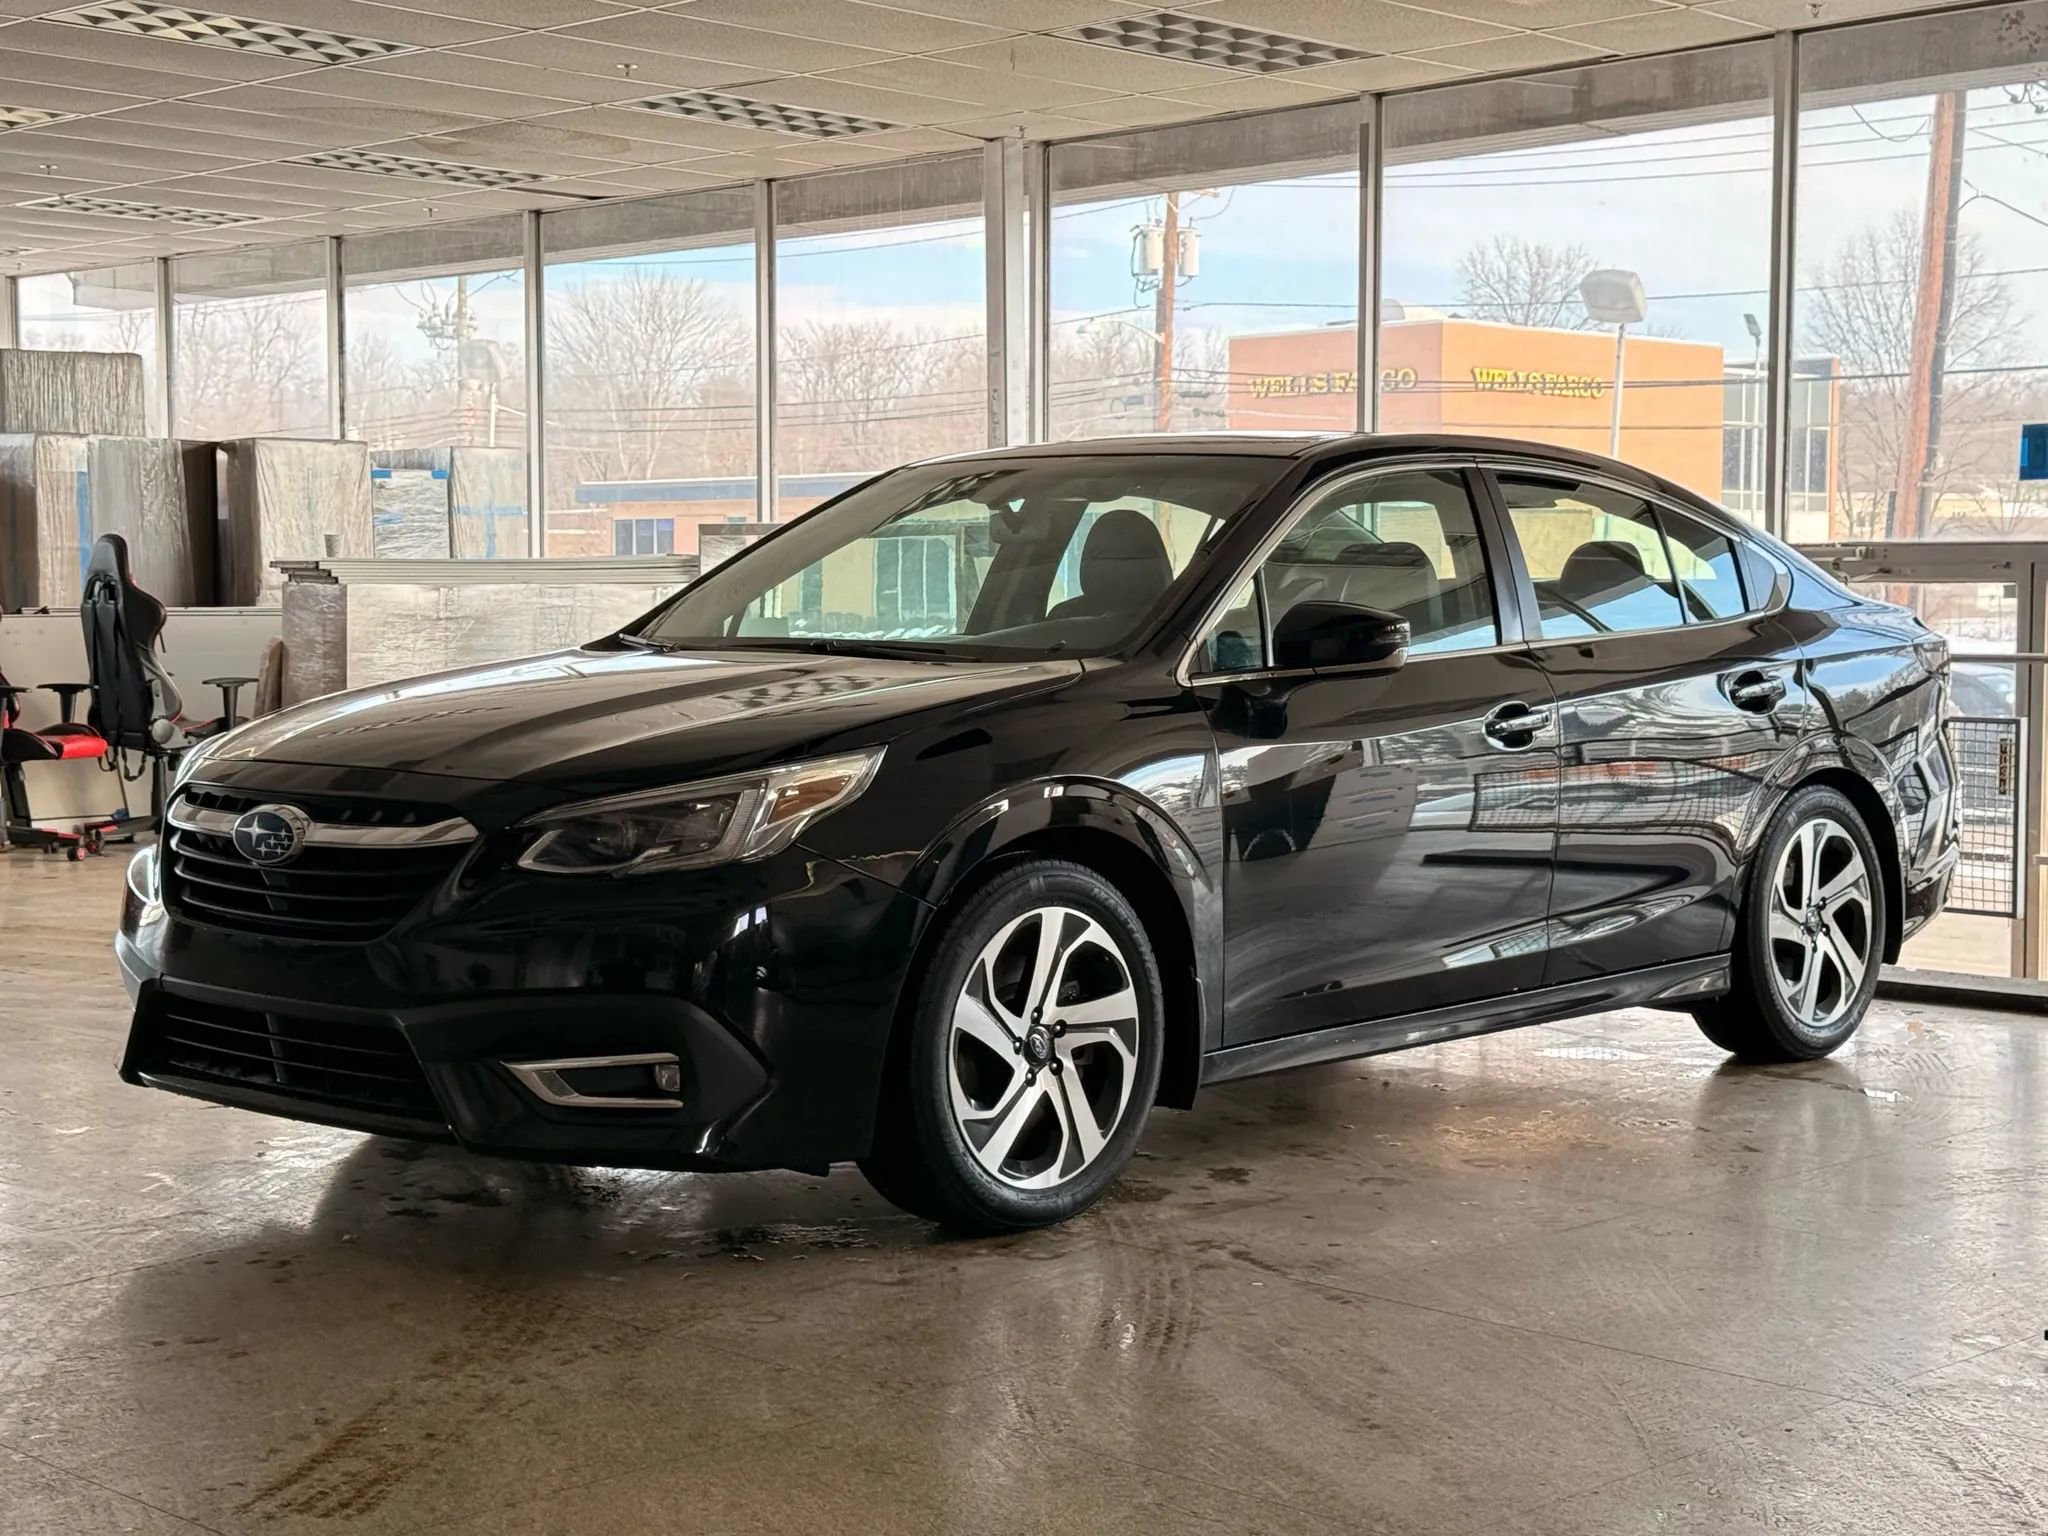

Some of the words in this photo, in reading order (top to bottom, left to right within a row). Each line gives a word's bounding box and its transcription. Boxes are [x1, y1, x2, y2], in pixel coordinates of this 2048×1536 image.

[1248, 373, 1330, 398] WELLS
[1332, 368, 1418, 394] FAGO
[1471, 367, 1542, 394] WELLS
[1542, 372, 1605, 399] FARGO
